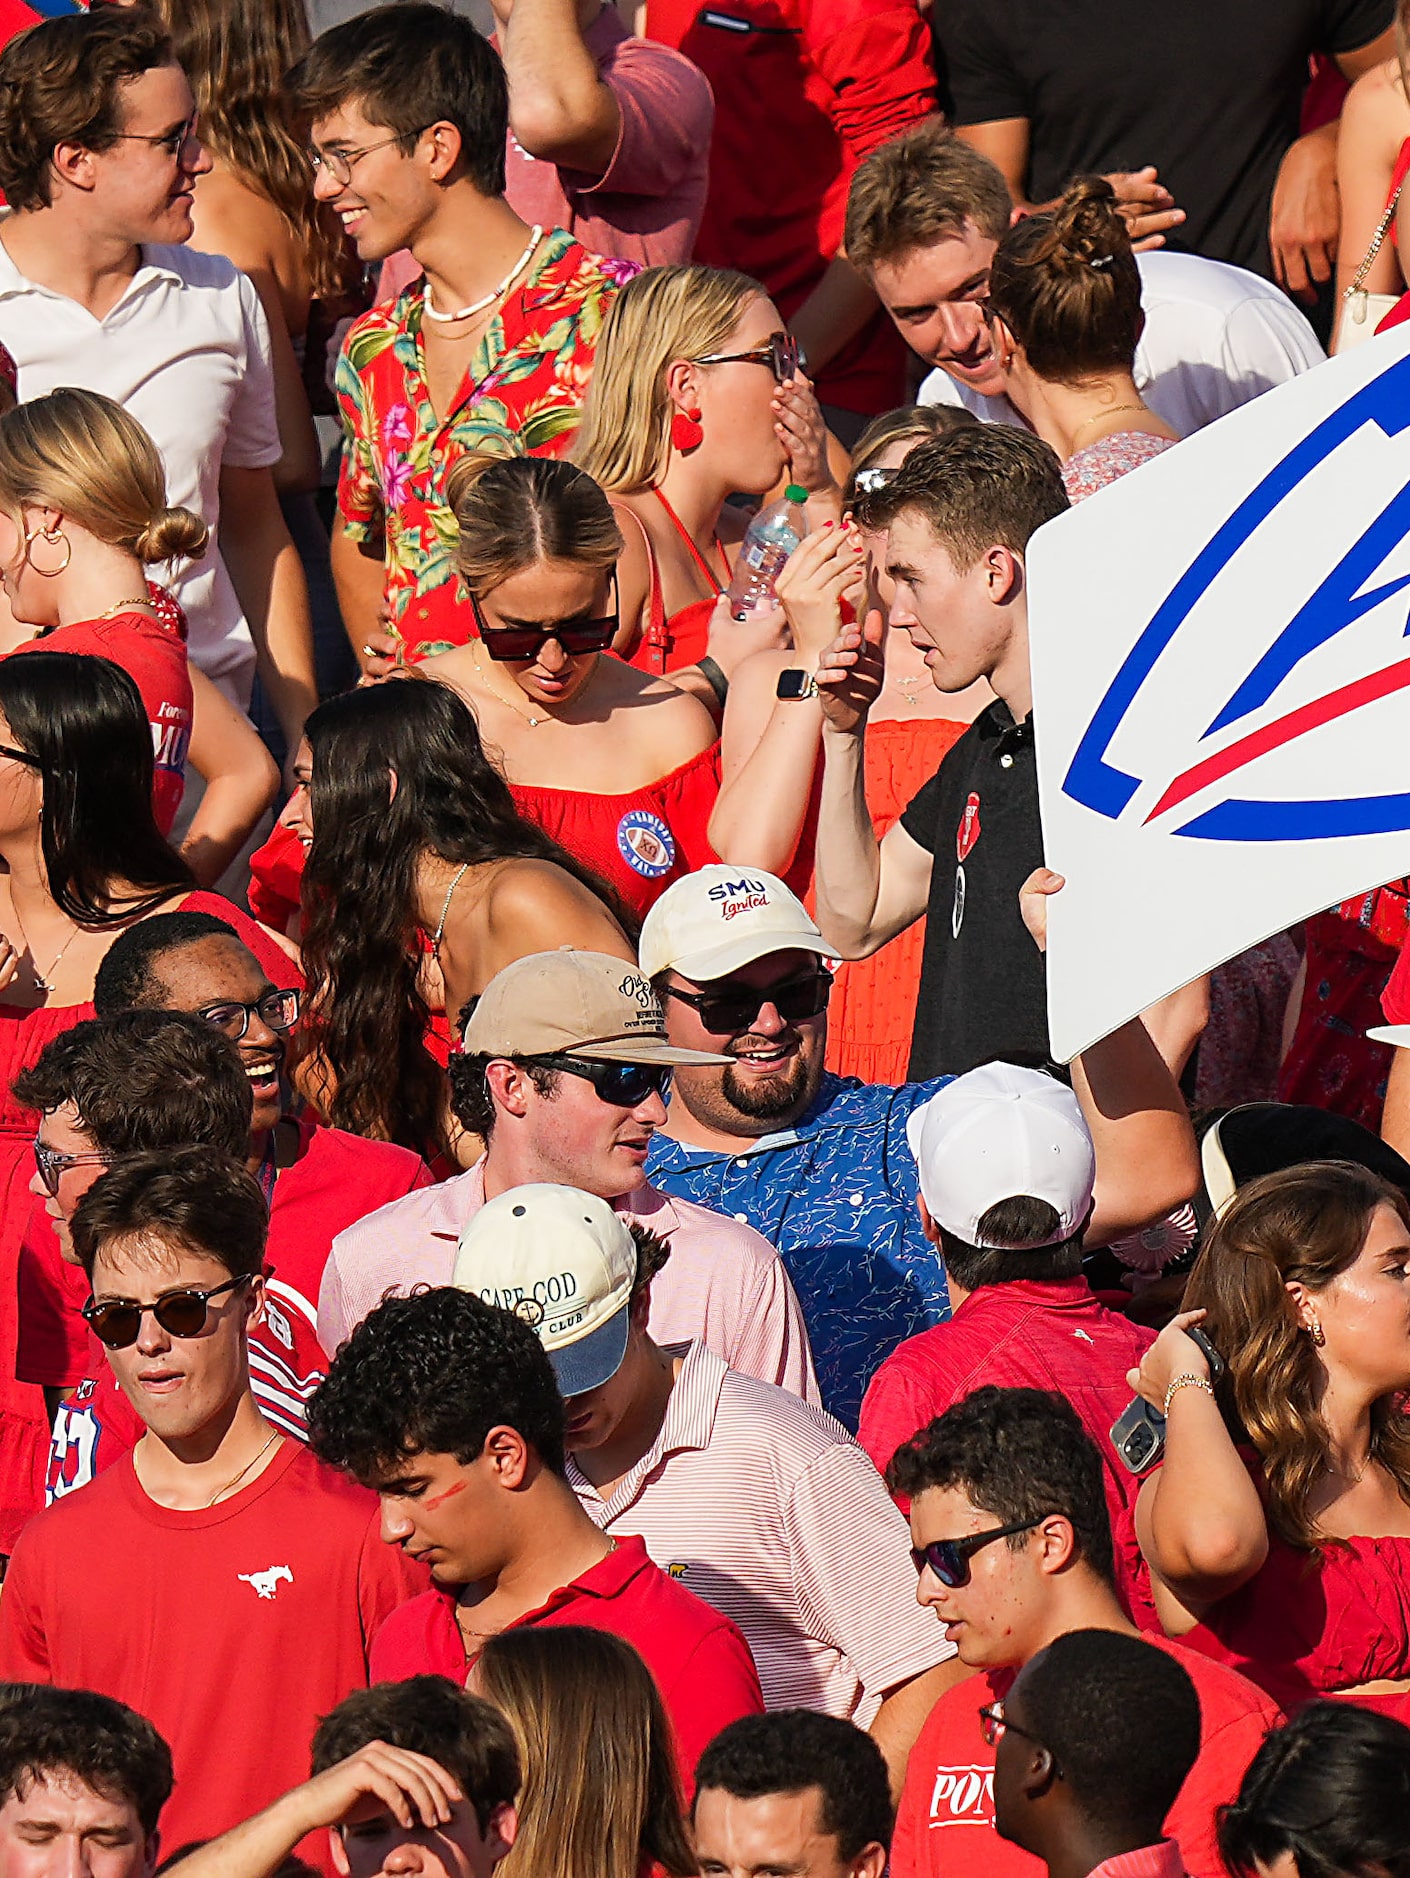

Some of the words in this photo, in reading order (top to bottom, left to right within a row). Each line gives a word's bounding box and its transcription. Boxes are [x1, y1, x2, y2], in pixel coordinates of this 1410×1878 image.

[708, 879, 767, 901] SMU
[721, 893, 771, 921] Ignited
[533, 1272, 577, 1306] COD
[549, 1312, 583, 1334] CLUB
[929, 1771, 996, 1818] PON
